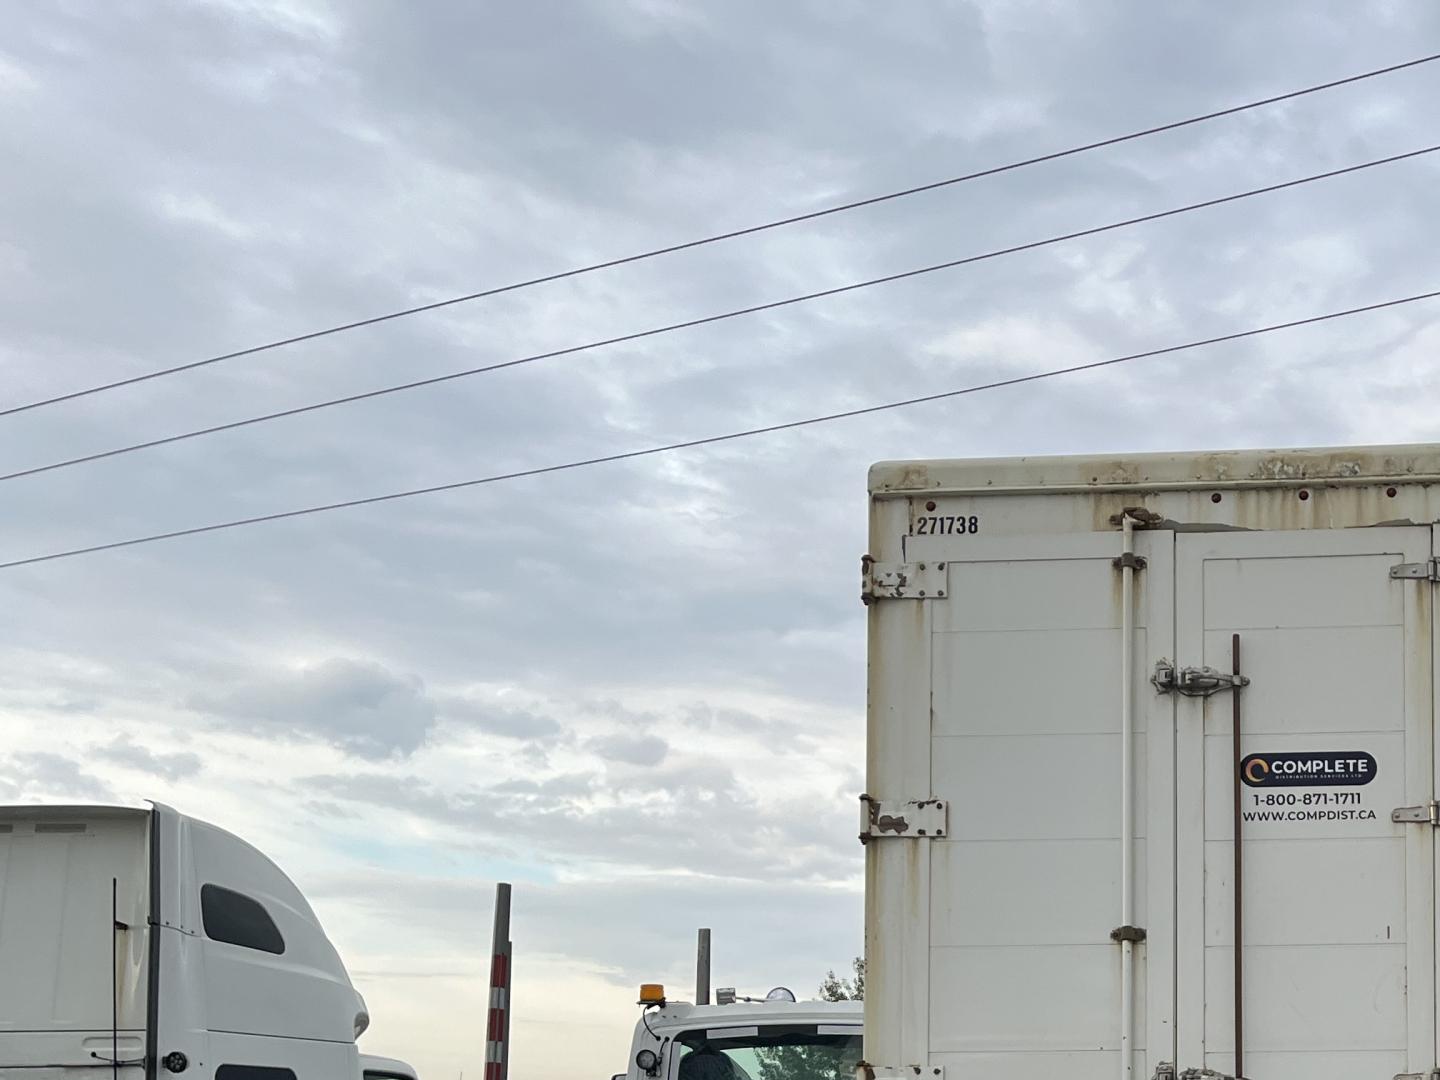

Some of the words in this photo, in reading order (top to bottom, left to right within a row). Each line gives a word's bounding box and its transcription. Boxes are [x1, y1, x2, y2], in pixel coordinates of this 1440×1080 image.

[917, 515, 979, 535] 271738
[1271, 759, 1369, 774] COMPLETE
[1253, 792, 1361, 806] 1-800-871-1711
[1243, 810, 1377, 822] WWW.COMPDIST.CA
